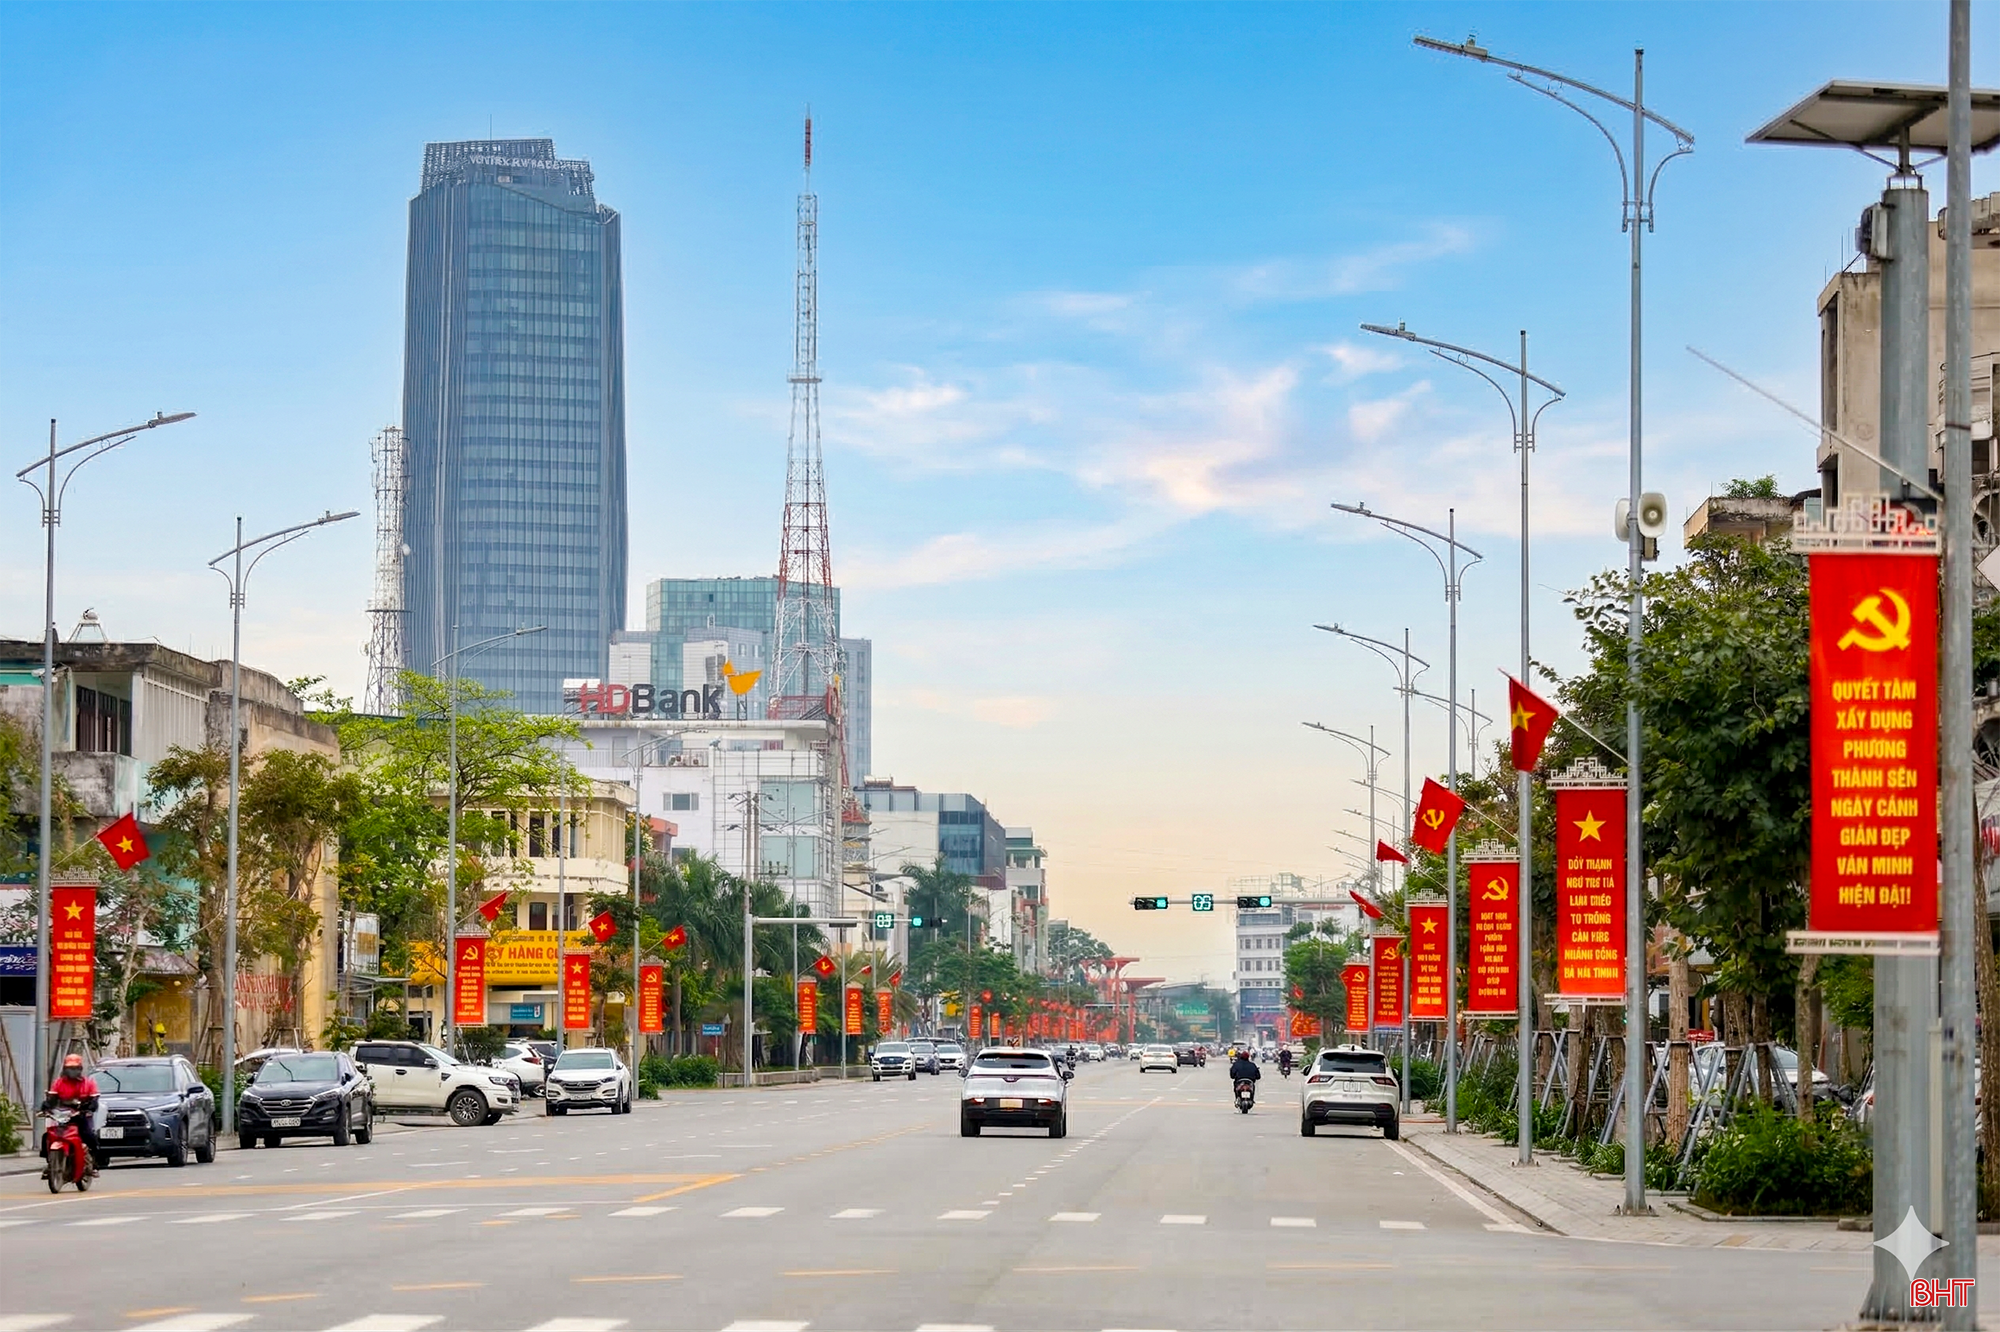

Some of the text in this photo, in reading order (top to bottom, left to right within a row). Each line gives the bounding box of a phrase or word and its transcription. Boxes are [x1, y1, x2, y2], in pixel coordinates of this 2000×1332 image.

[580, 682, 722, 719] HDBank
[1832, 676, 1880, 702] QUYẾT
[1872, 856, 1913, 875] MINH
[1838, 883, 1876, 908] HIỆN
[508, 945, 543, 959] HÀNG
